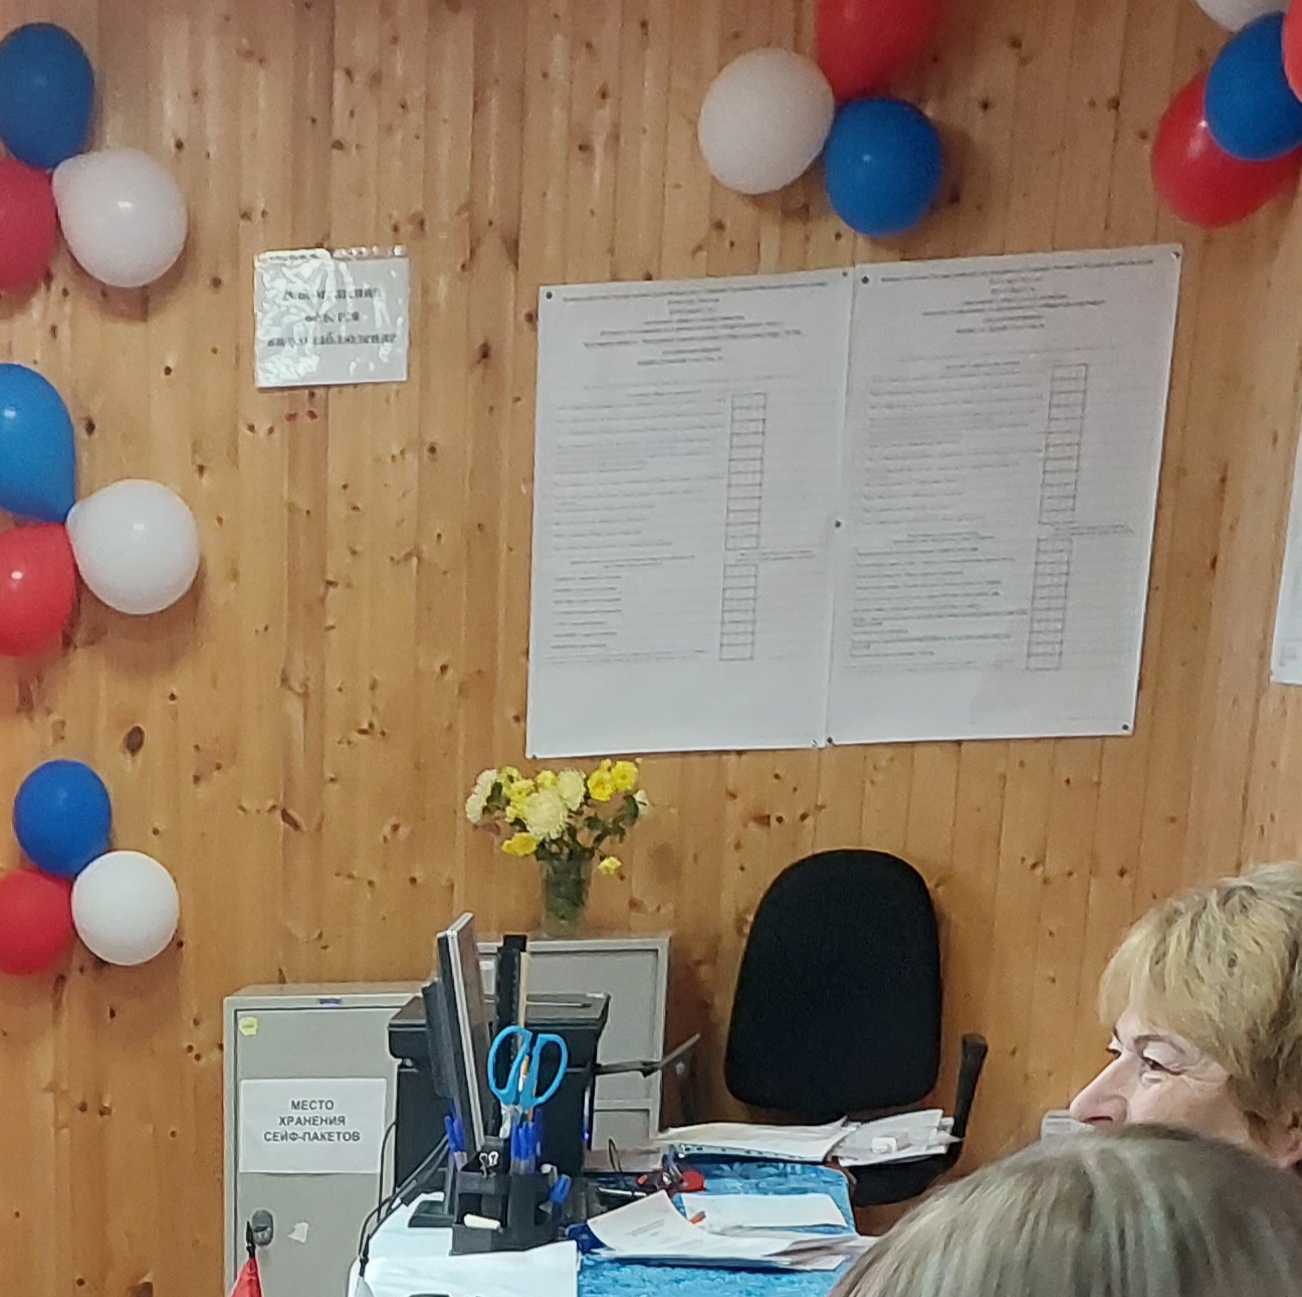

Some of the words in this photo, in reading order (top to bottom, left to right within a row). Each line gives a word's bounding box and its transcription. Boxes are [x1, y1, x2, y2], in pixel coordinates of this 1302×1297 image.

[290, 1099, 335, 1111] МЕСТО
[278, 1115, 347, 1126] ХРАНЕНИЯ
[263, 1129, 361, 1142] СЕЙФ-ПАКЕТОВ
